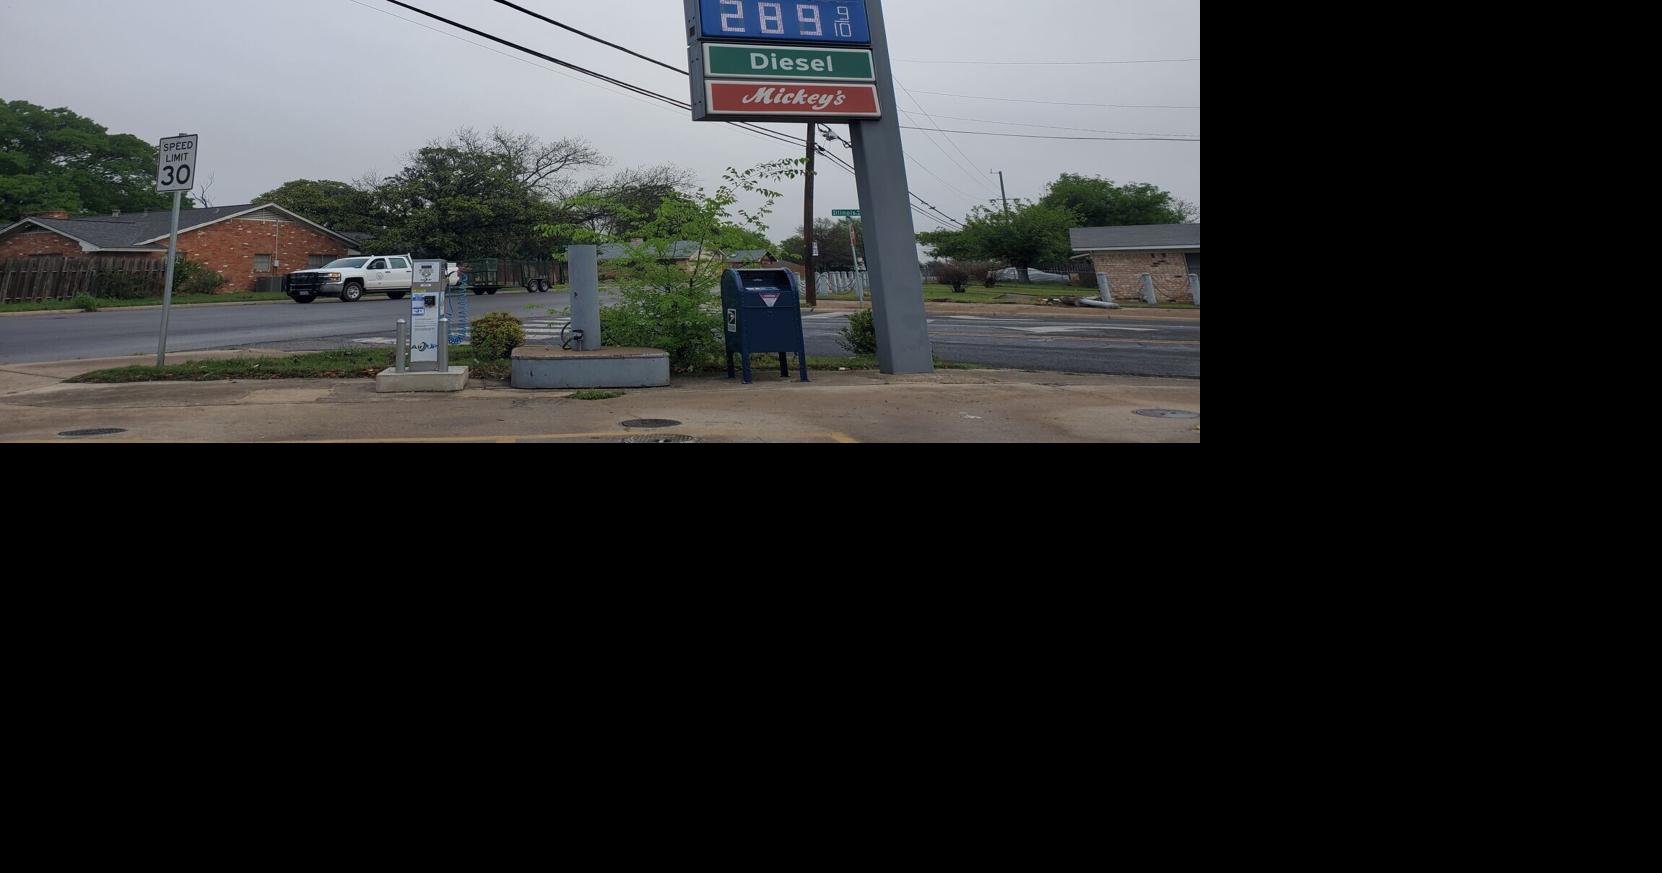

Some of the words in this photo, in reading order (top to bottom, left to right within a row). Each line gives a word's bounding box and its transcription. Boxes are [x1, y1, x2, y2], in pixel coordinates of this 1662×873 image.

[720, 0, 822, 36] 289
[837, 6, 849, 20] 9
[834, 22, 851, 37] 10
[750, 53, 833, 72] Diesel
[742, 87, 846, 110] Mickey's
[163, 141, 193, 151] SPEED
[166, 153, 188, 162] LIMIT
[161, 164, 190, 185] 30
